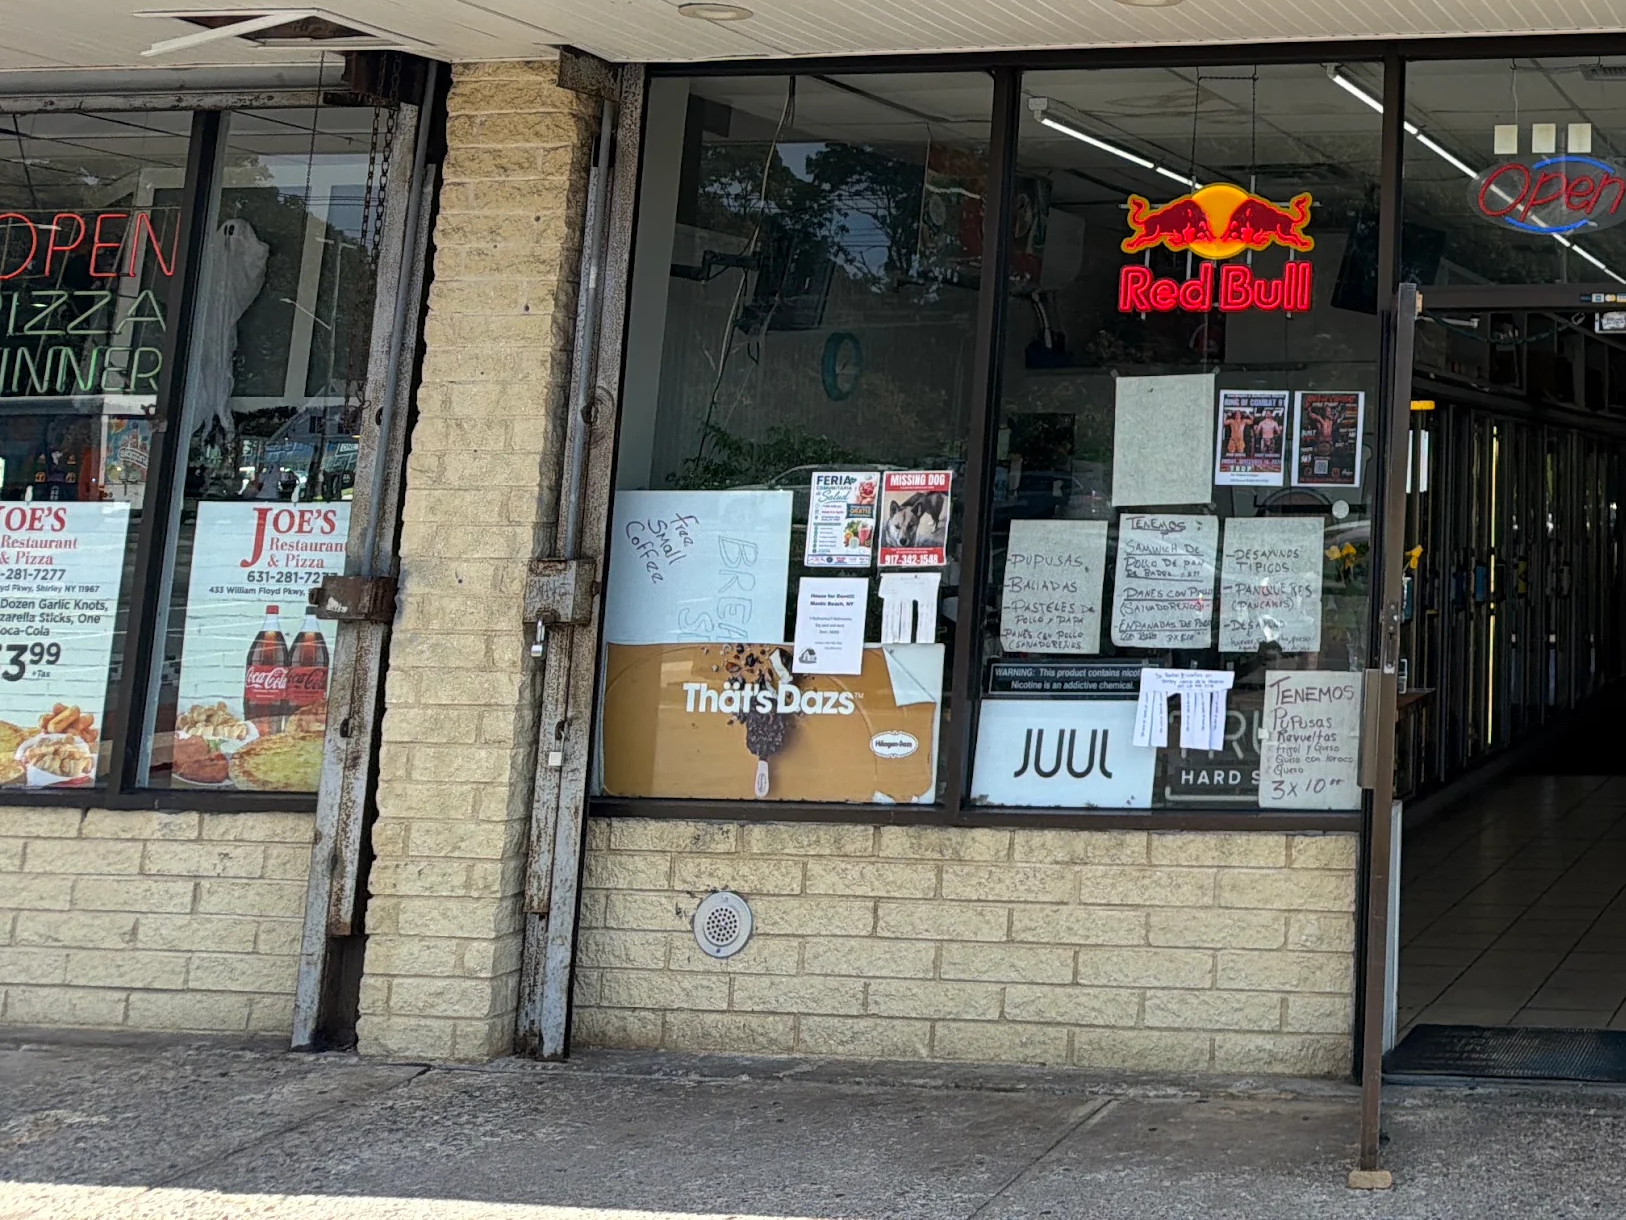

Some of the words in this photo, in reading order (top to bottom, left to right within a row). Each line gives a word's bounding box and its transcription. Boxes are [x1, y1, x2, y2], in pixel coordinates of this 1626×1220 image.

[0, 212, 182, 280] OPEN
[1118, 262, 1212, 312] Red
[1219, 262, 1313, 312] Bull
[0, 290, 166, 336] IZZA
[816, 475, 852, 486] FERIA
[890, 474, 926, 486] MISSING
[928, 474, 945, 486] DOG
[0, 506, 67, 532] OE'S
[1, 535, 78, 549] Restaurant
[240, 507, 337, 568] JOE'S
[15, 551, 54, 565] Pizza
[267, 554, 279, 568] &
[285, 553, 325, 568] Pizza
[64, 585, 76, 593] NY
[209, 586, 224, 594] 433
[226, 586, 256, 595] William
[258, 586, 281, 596] Floyd
[0, 599, 35, 609] Dozen
[38, 599, 71, 610] Garlic
[73, 599, 109, 612] Knots,
[38, 612, 75, 625] Sticks,
[77, 613, 101, 624] One
[0, 625, 50, 636] oca-Cola
[994, 668, 1035, 678] WARNING:
[1039, 668, 1056, 677] This
[1056, 669, 1088, 679] product
[1089, 668, 1120, 678] contains
[1011, 681, 1042, 690] Nicotine
[1044, 681, 1050, 689] is
[1052, 682, 1062, 690] an
[1063, 681, 1097, 690] addictive
[1098, 681, 1135, 690] chemical.
[1269, 676, 1355, 705] TENEMOS
[683, 682, 774, 714] Thät's
[1013, 728, 1113, 779] JUUL
[1181, 770, 1241, 785] HARD
